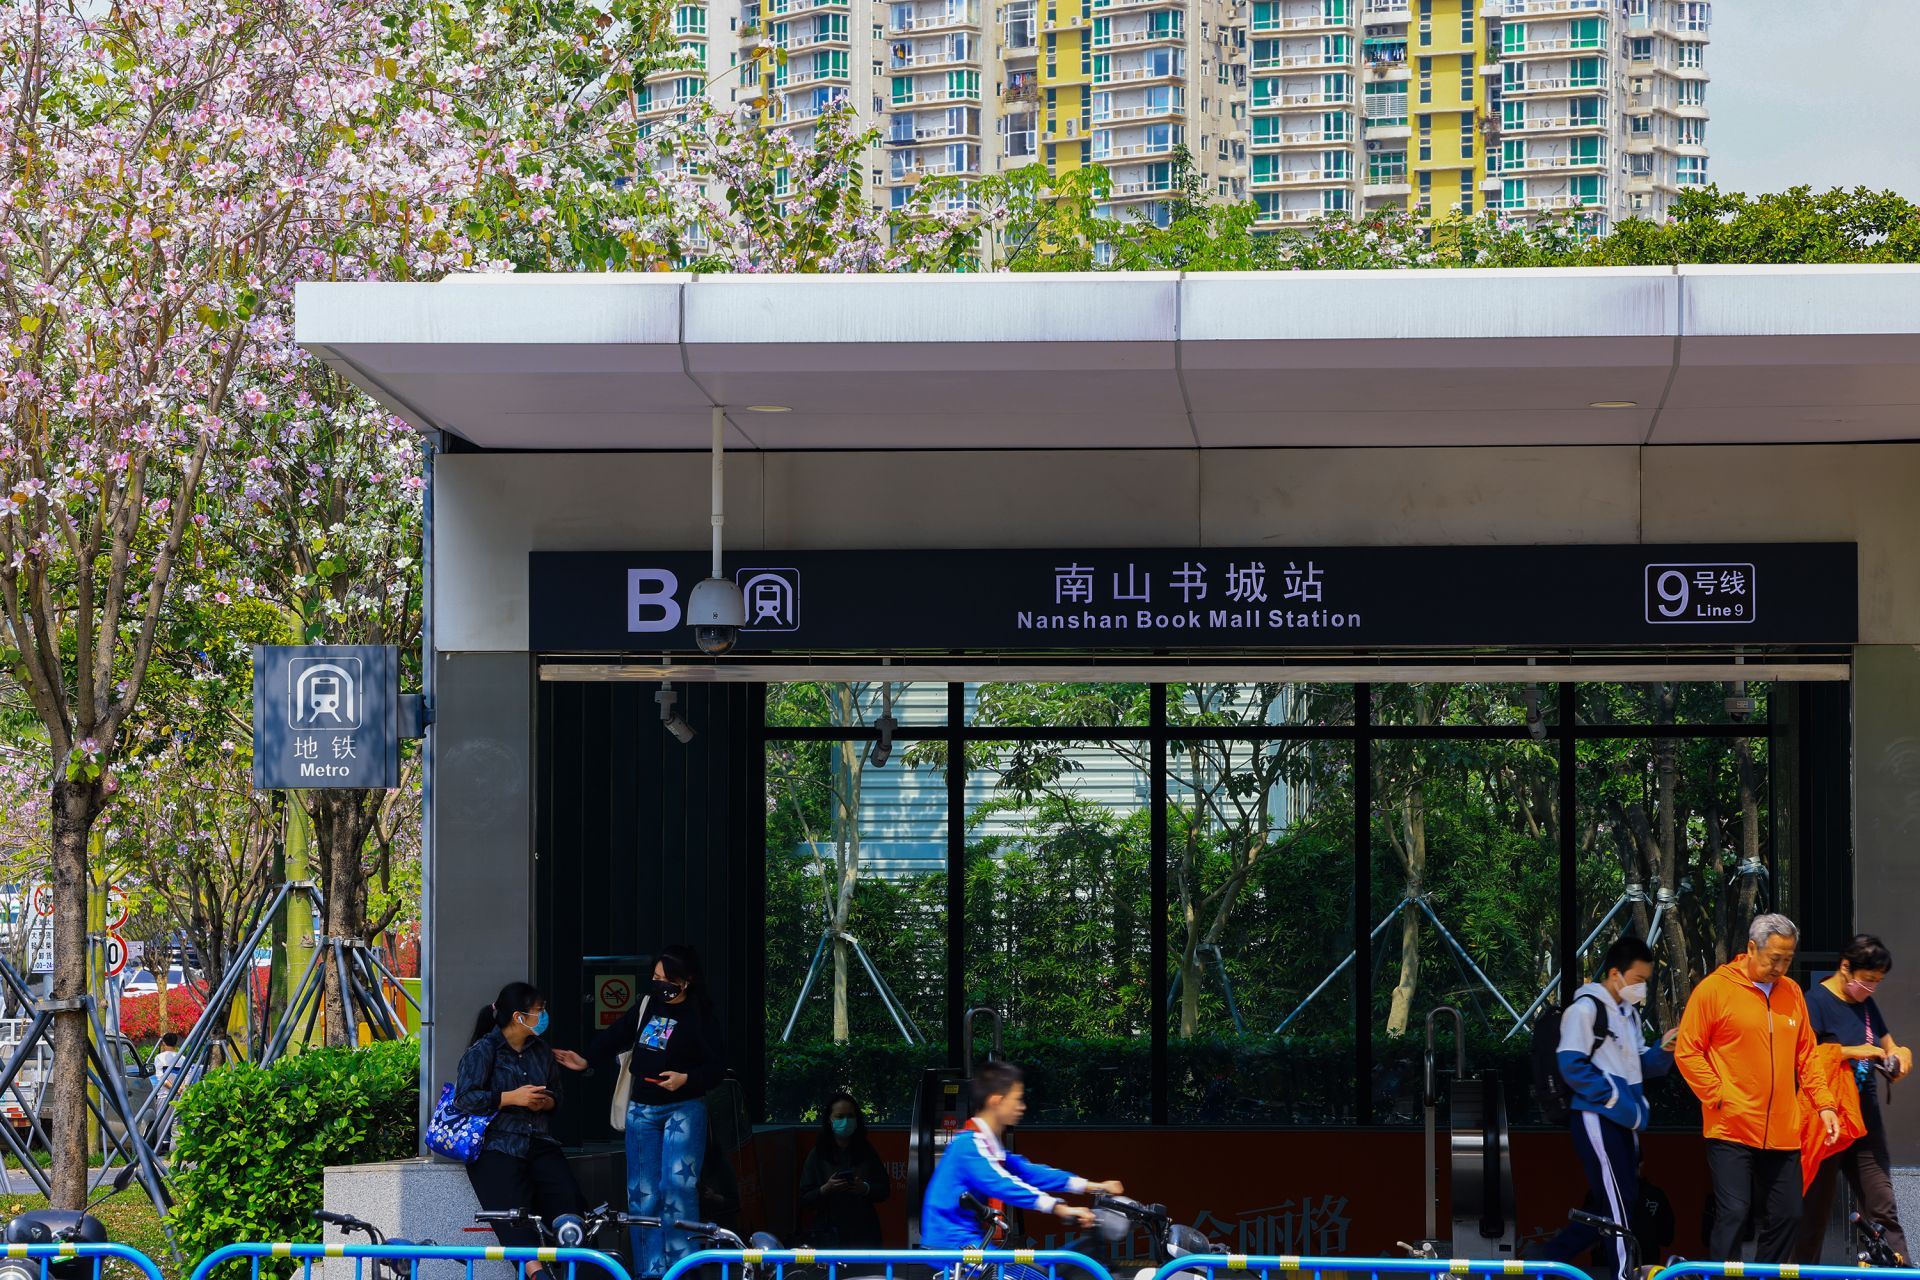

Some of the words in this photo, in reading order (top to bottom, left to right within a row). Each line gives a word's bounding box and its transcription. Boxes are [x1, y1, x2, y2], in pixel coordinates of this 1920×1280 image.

[1054, 560, 1325, 604] 南山书城站
[1656, 570, 1690, 618] 9
[1693, 570, 1747, 596] 号线
[627, 568, 682, 633] B
[1696, 604, 1732, 617] Line
[1734, 603, 1744, 617] 9
[1017, 611, 1128, 630] Nanshan
[1137, 609, 1201, 629] Book
[1208, 609, 1261, 629] Mall
[1268, 608, 1362, 629] Station
[293, 735, 357, 760] 地铁
[300, 763, 350, 777] Metro
